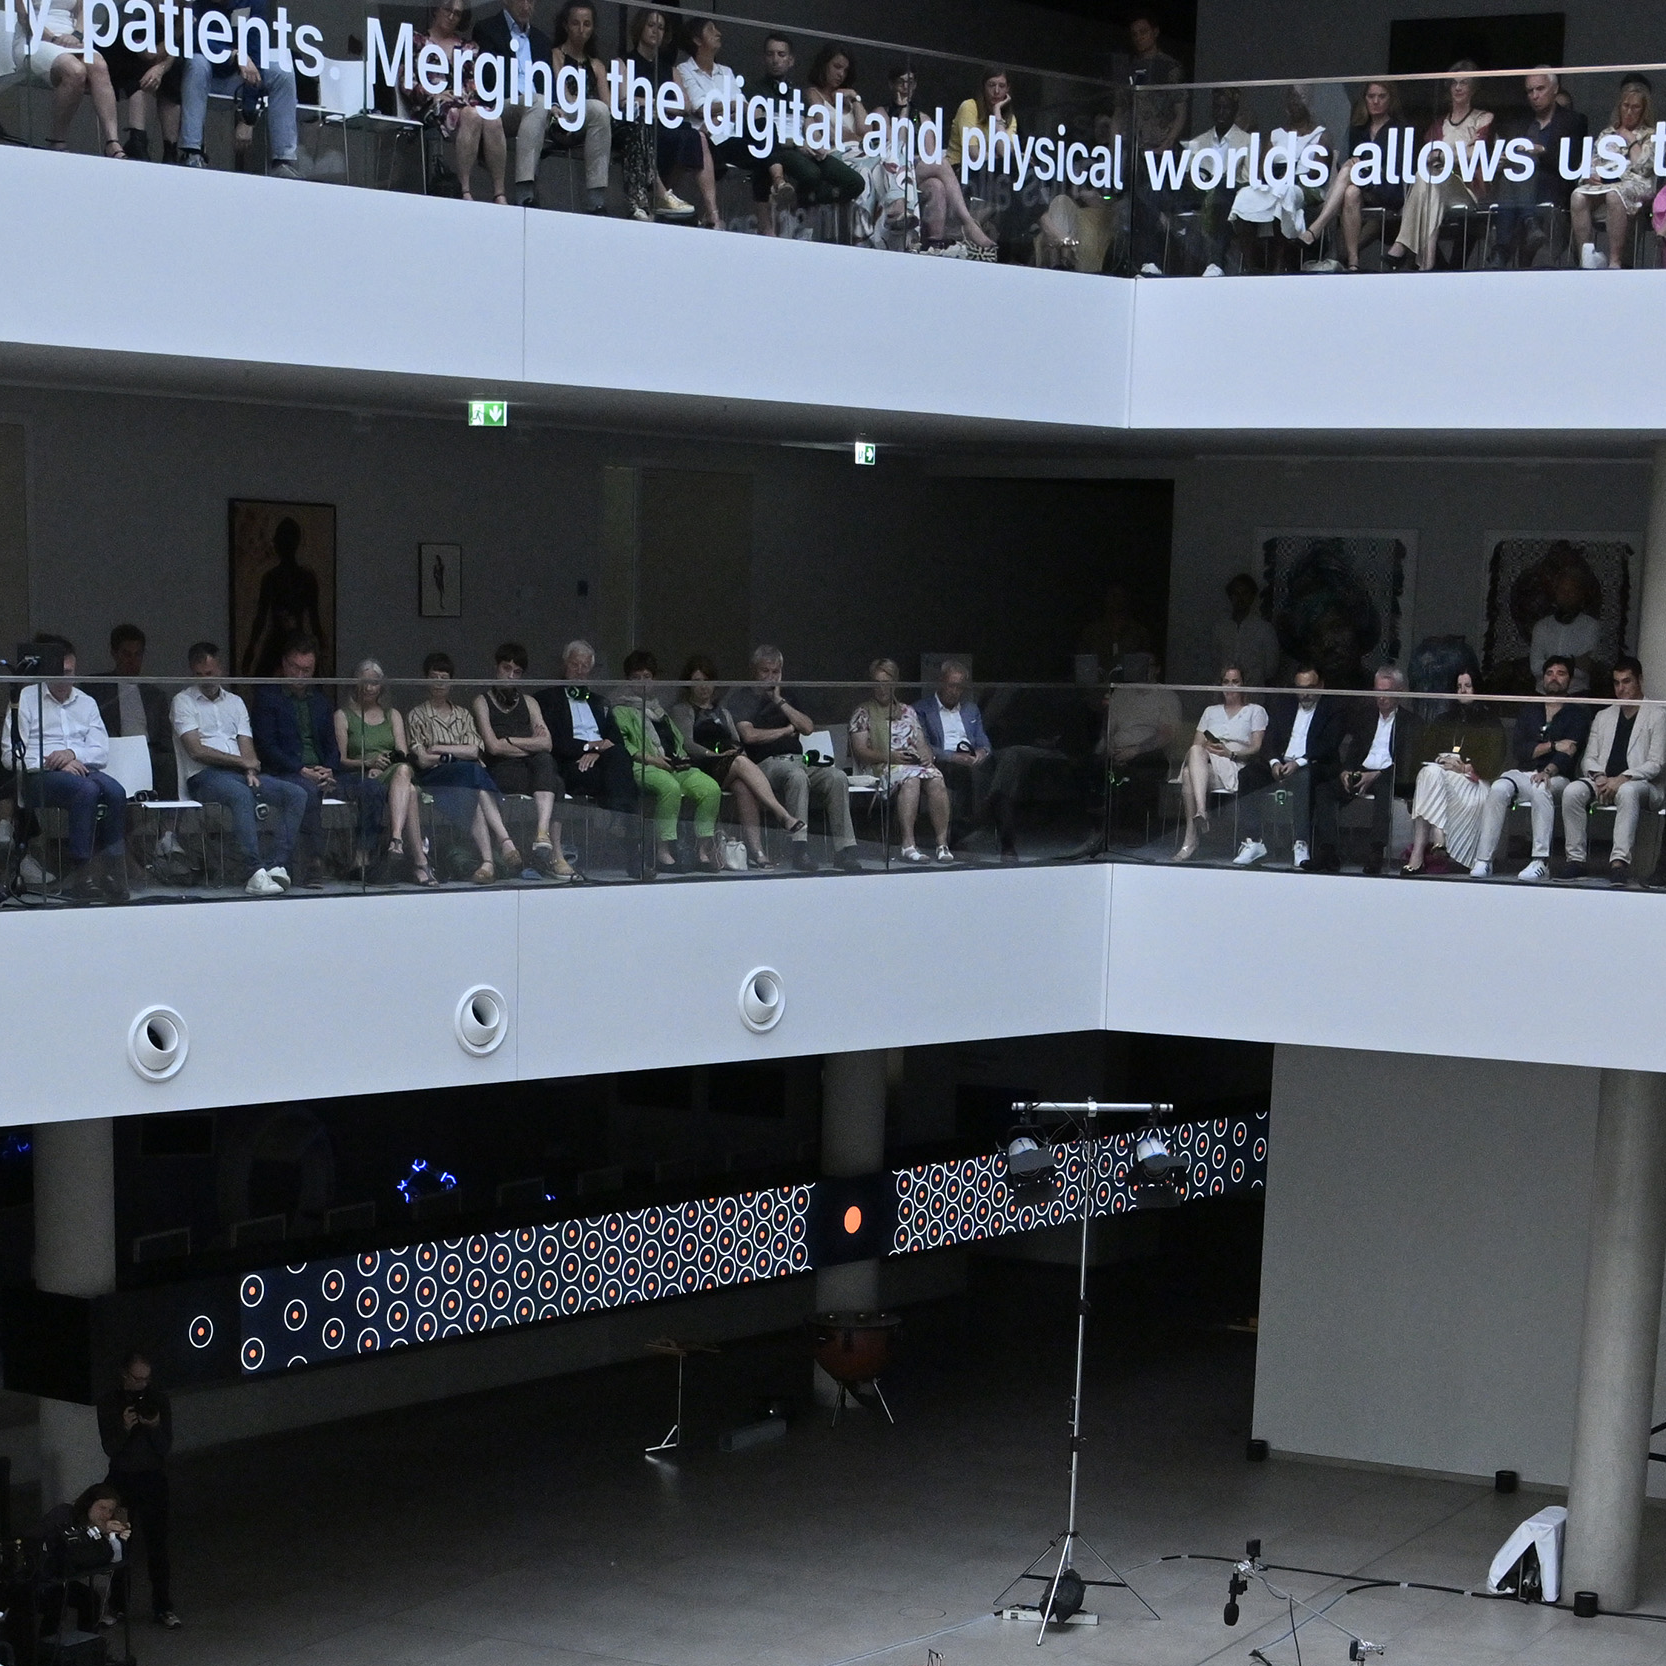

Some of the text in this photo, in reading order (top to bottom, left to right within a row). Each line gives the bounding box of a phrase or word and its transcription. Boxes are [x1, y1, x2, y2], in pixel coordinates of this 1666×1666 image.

[83, 0, 340, 80] patients.
[367, 17, 587, 133] Merging
[607, 59, 685, 129] the
[704, 71, 846, 159] digital
[863, 107, 943, 165] and
[962, 115, 1123, 191] physical
[1144, 131, 1329, 191] worlds
[1350, 126, 1535, 187] allows
[1558, 134, 1628, 180] us
